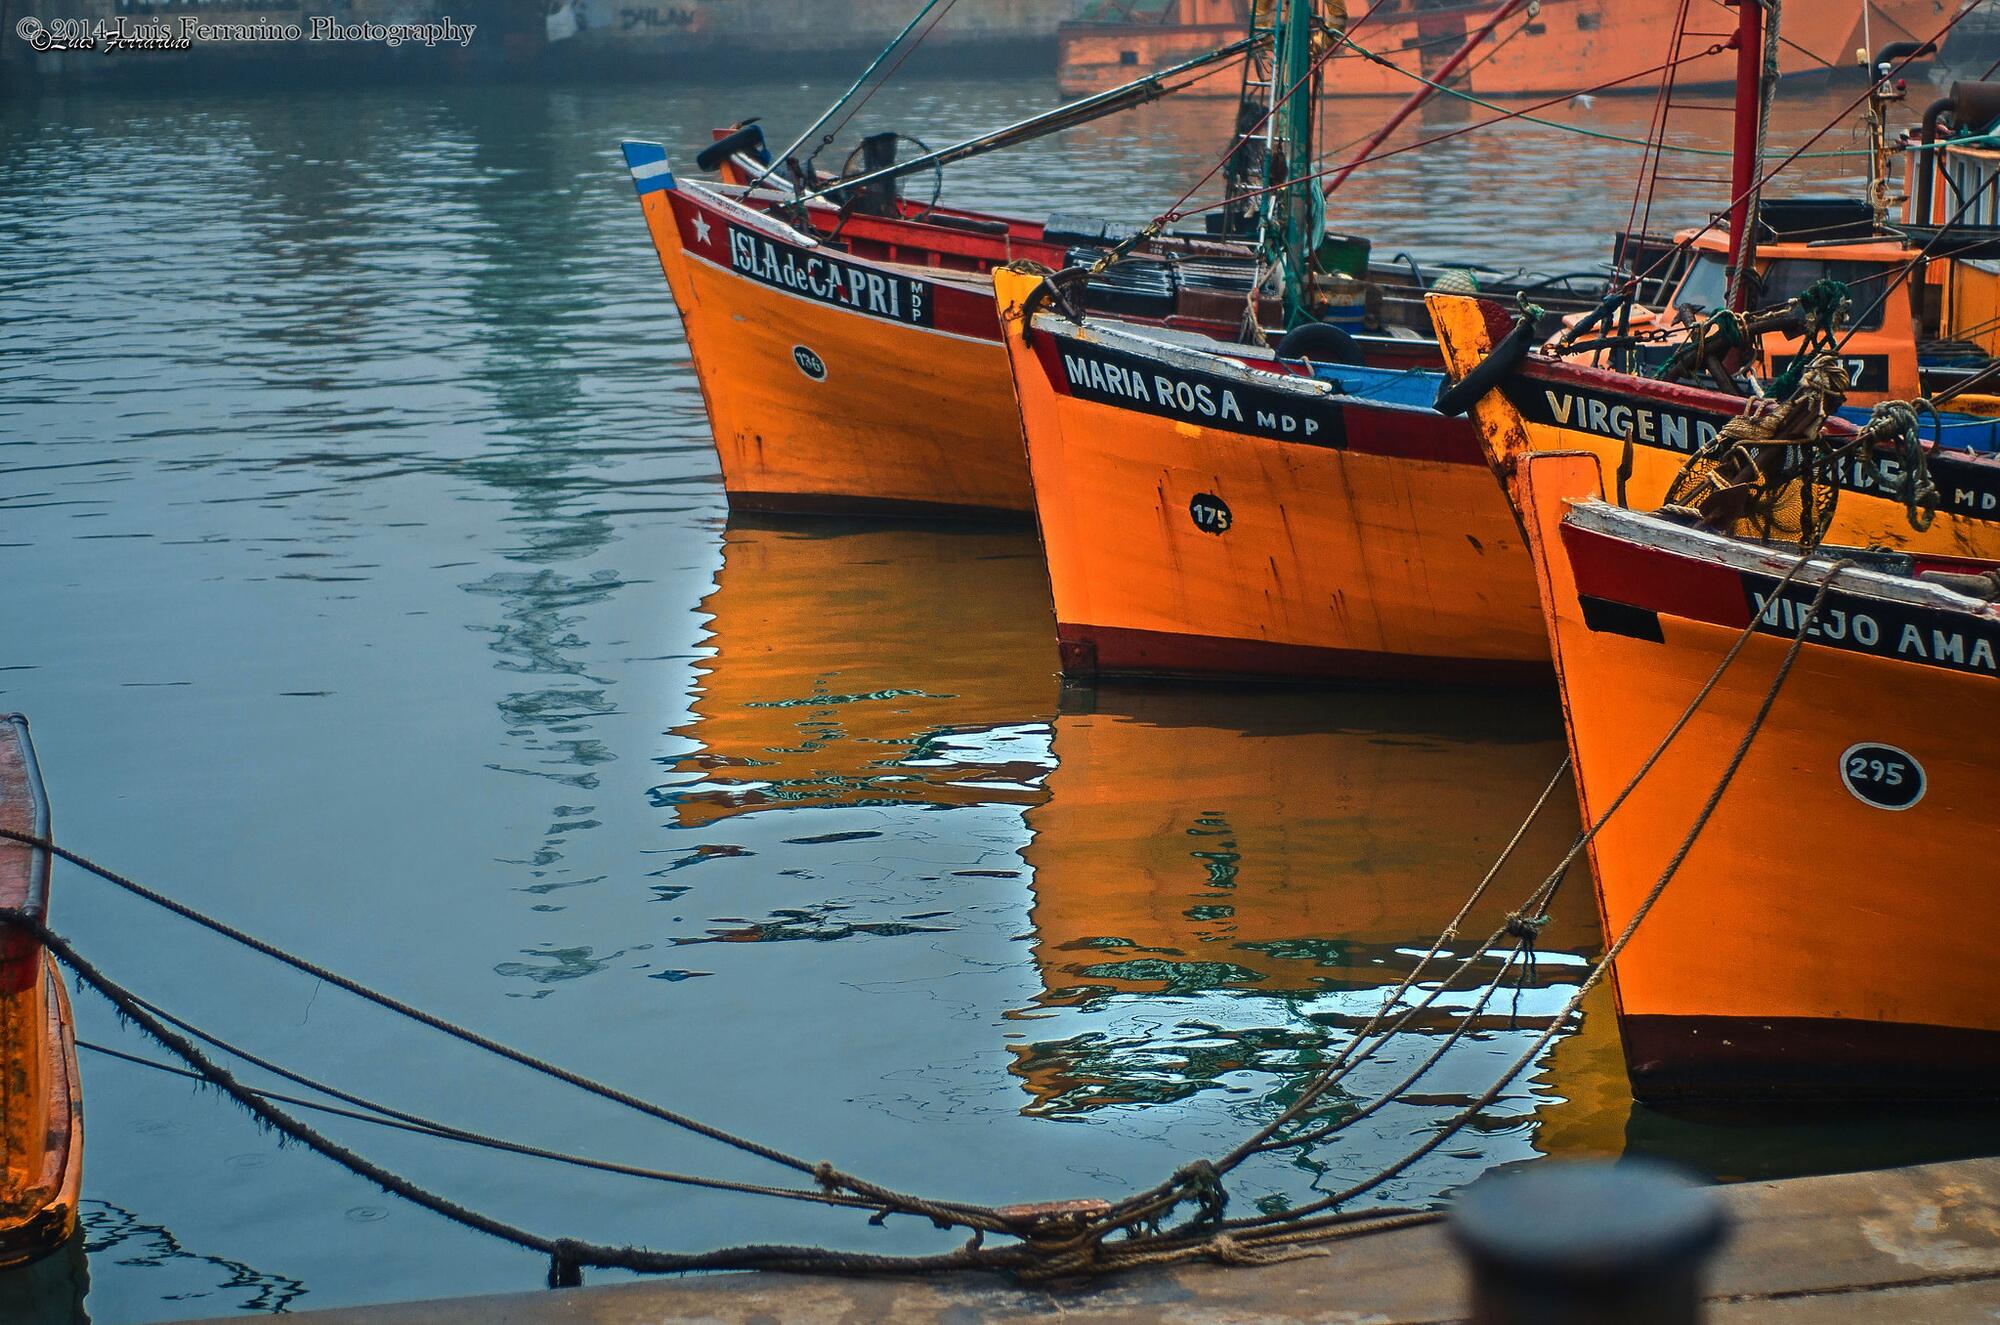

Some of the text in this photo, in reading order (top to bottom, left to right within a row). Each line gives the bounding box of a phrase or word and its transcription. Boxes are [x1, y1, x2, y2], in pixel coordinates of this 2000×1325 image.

[729, 227, 901, 317] ISLA de CAPRI
[1064, 354, 1150, 402] MARIA
[1154, 375, 1245, 423] ROSA
[1545, 390, 1688, 450] VIRGEN
[1193, 504, 1228, 529] 175
[1754, 592, 1997, 670] VIEJO AMA
[1849, 757, 1905, 785] 295
